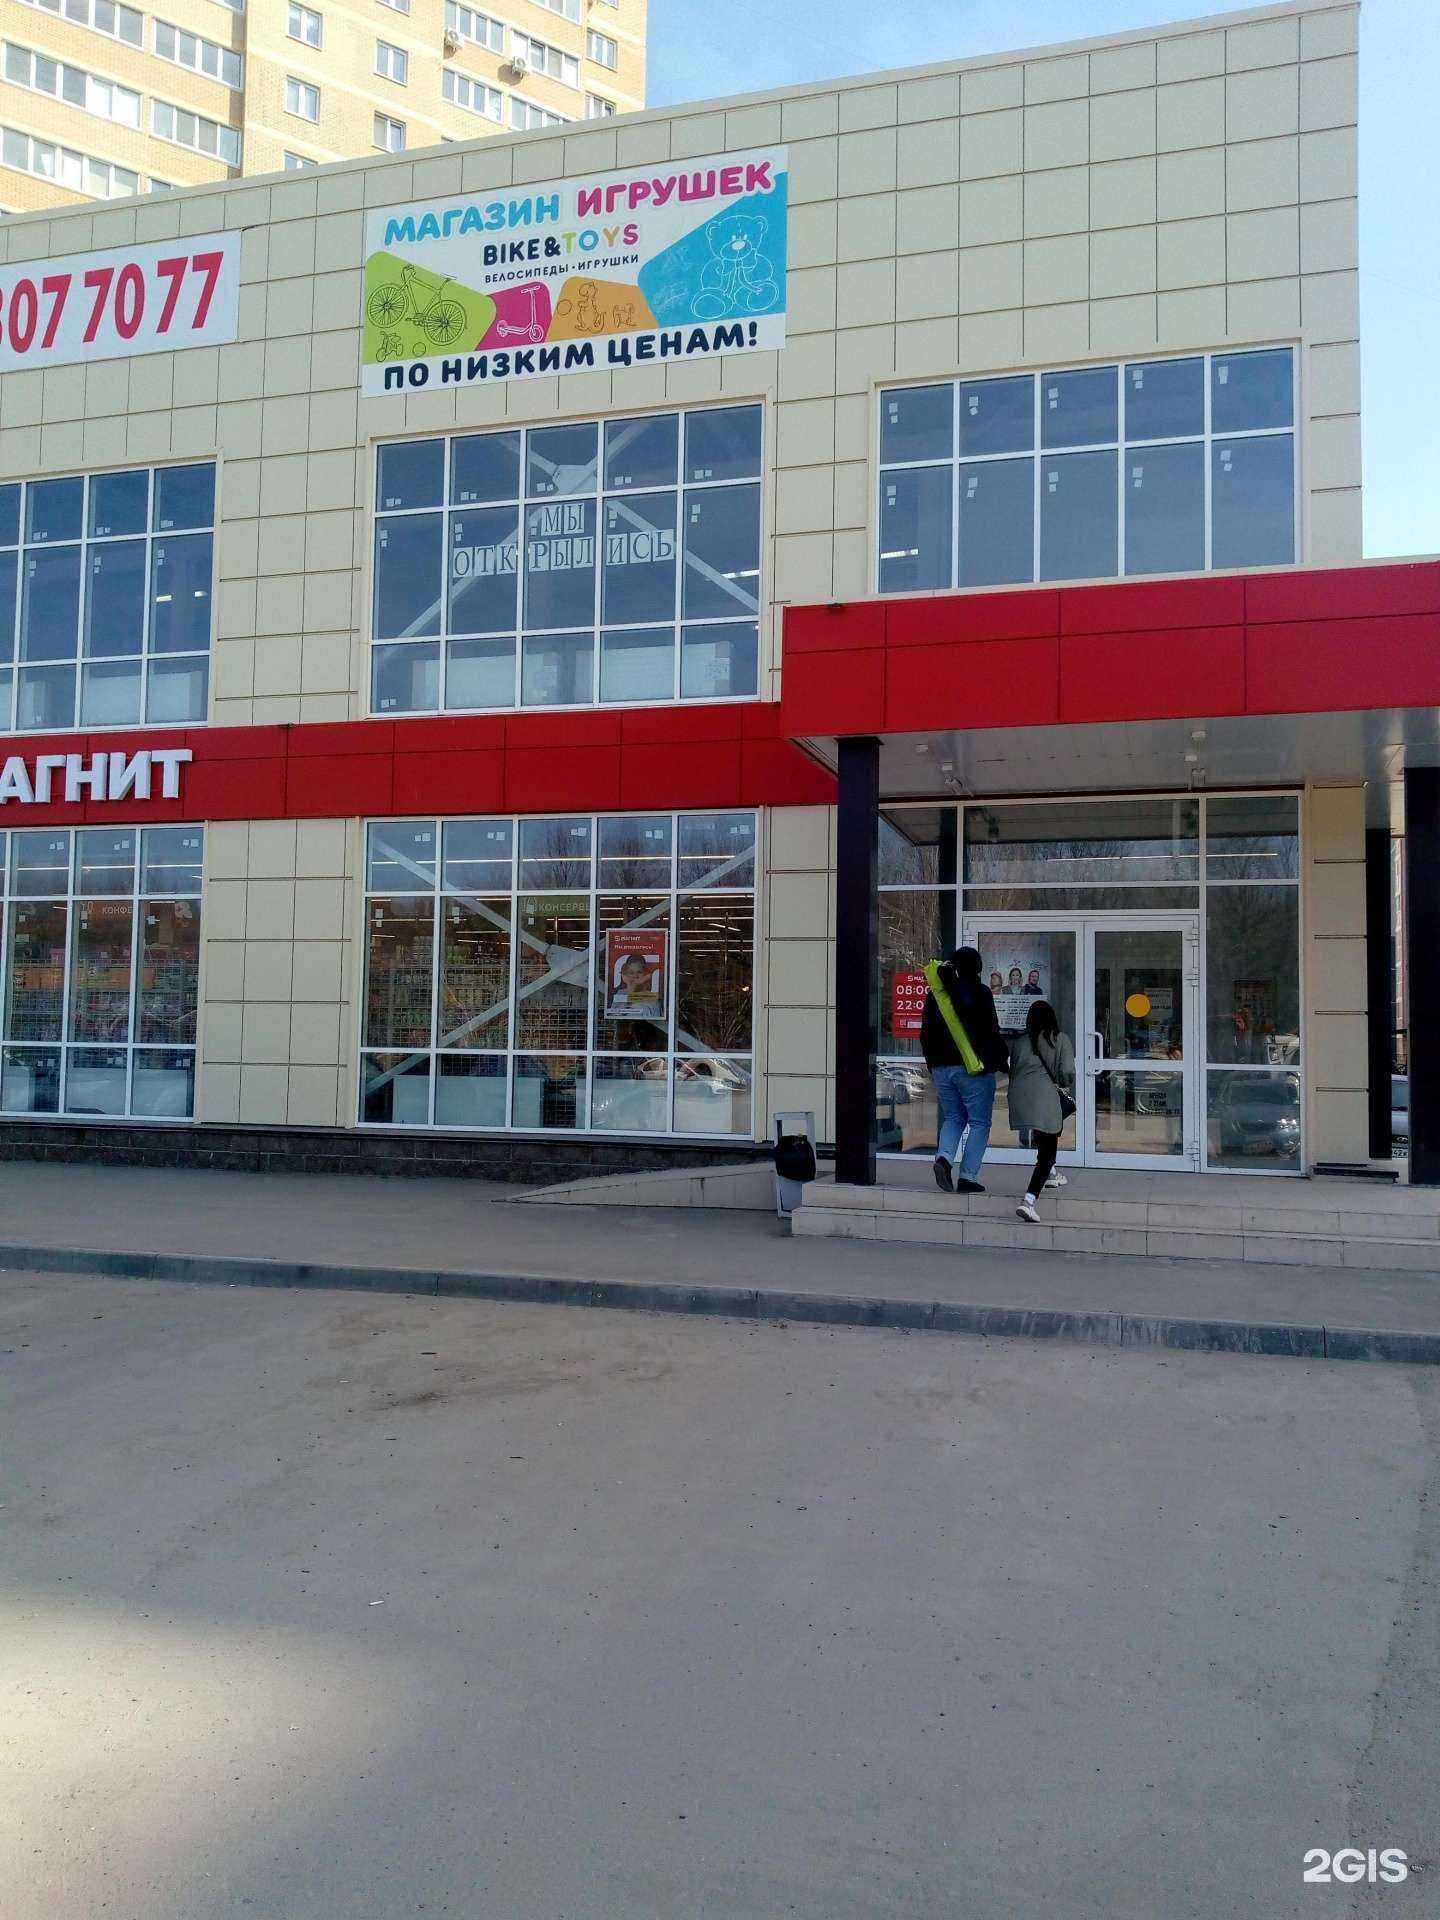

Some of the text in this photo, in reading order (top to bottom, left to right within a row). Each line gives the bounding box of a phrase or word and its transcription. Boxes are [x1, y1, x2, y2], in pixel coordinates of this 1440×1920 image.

[384, 161, 772, 245] МАГАЗИН ИГРУШЕК
[483, 223, 639, 266] BIKE&TOYS
[485, 254, 639, 284] ВЕЛОСИПЕДЫ ИГРУШКИ
[384, 321, 758, 390] ПО НИЗКИМ ЦЕНАМ!
[543, 505, 584, 532] МЫ
[454, 529, 673, 576] ОТКРЫЛИСЬ
[896, 1000, 925, 1010] 22:0
